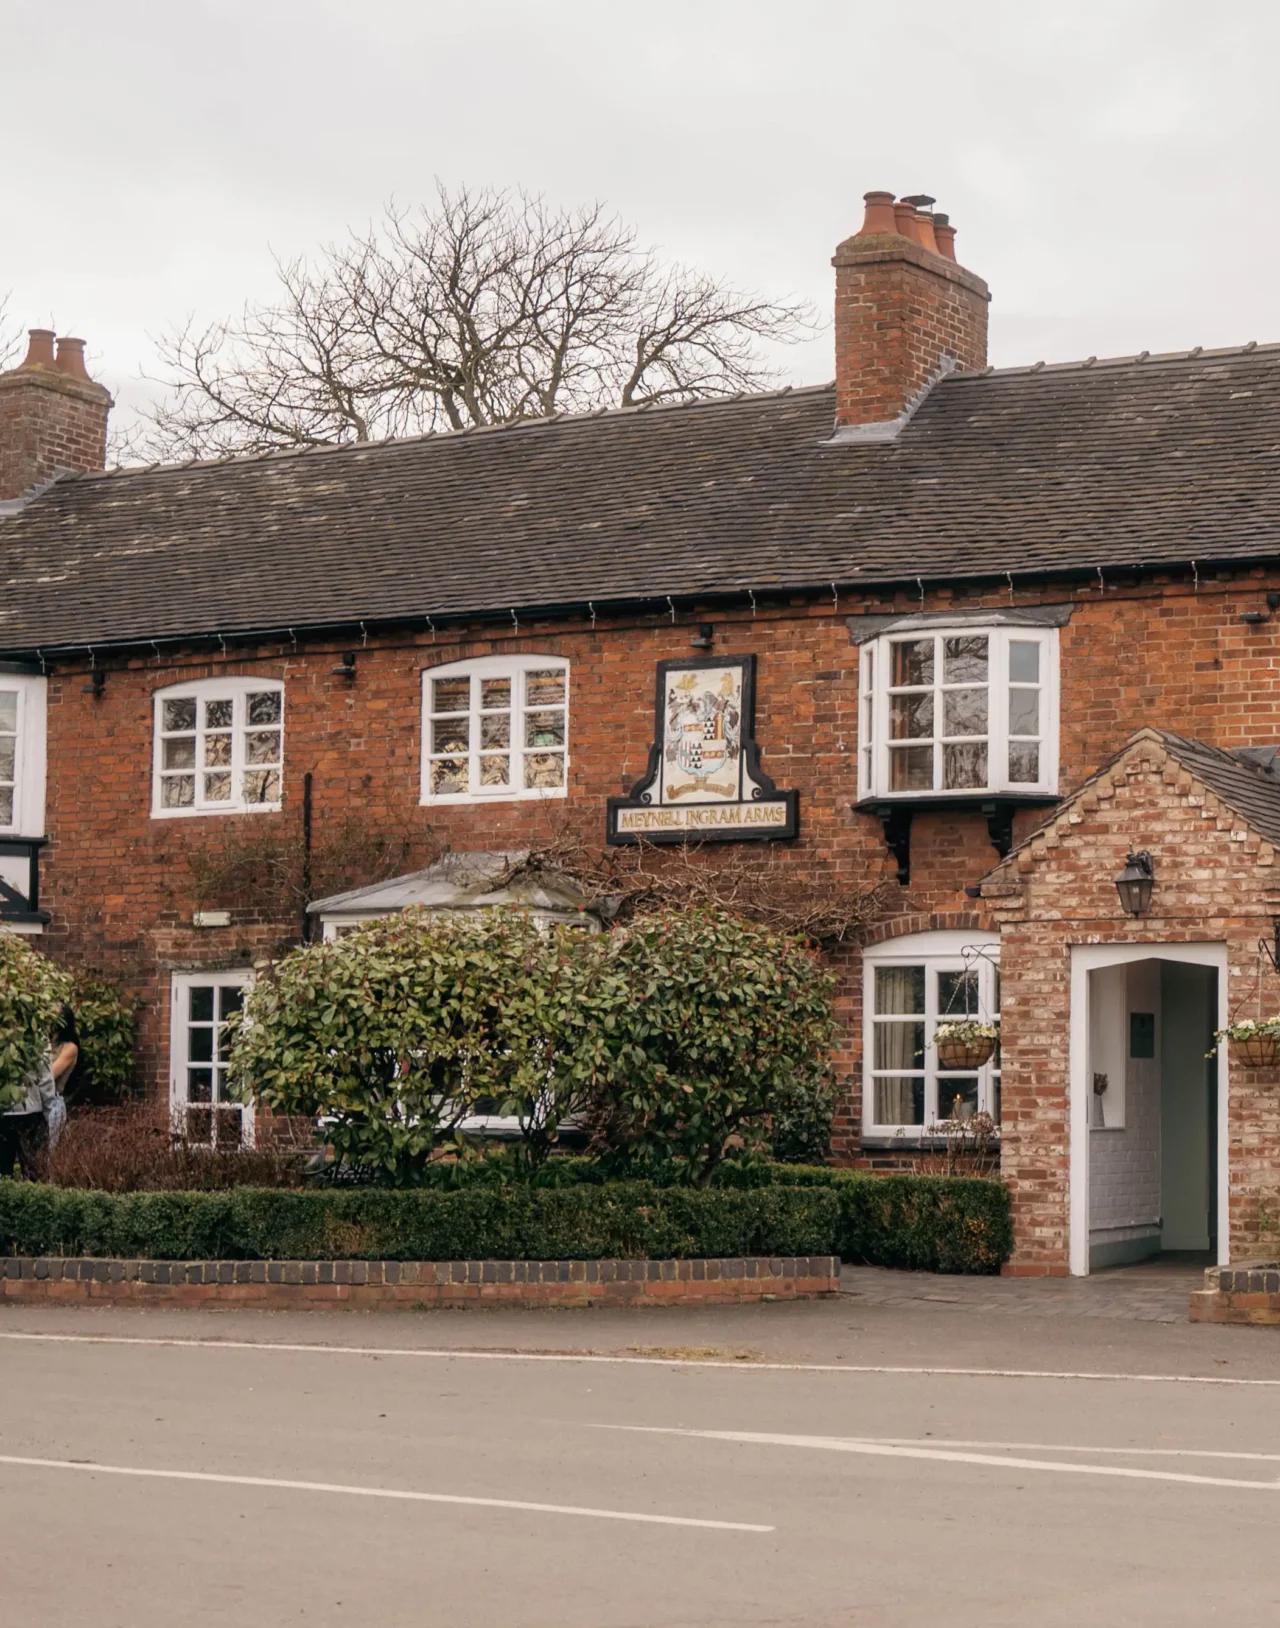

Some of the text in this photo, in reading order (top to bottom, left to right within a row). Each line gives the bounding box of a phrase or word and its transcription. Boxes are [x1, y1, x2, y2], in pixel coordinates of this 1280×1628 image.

[621, 806, 785, 828] MEYNELL INGRAM ARMS
